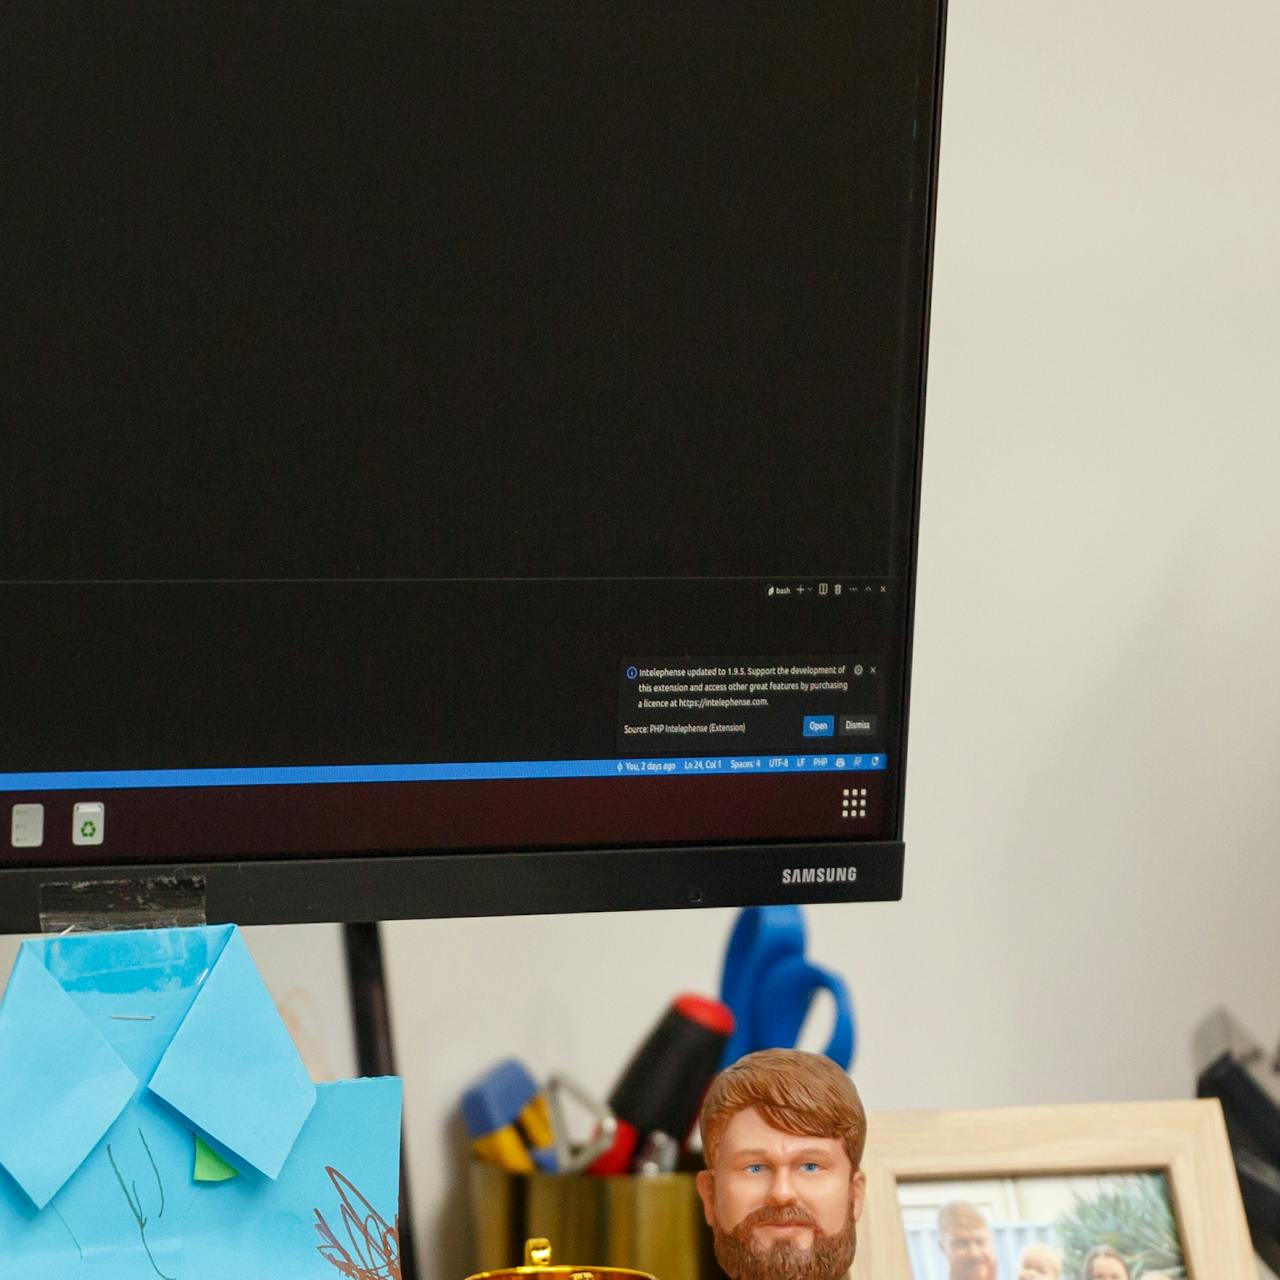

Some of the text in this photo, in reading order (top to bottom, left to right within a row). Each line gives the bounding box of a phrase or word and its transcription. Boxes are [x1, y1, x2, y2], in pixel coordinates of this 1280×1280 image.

[776, 586, 791, 595] bash
[639, 666, 686, 678] Intelephense
[687, 665, 716, 678] updated
[718, 665, 727, 676] to
[747, 665, 776, 677] Support
[777, 664, 790, 675] the
[790, 664, 837, 676] development
[838, 664, 846, 674] of
[638, 681, 848, 693] this extension and access other great features by purchasing
[643, 699, 669, 708] licence
[669, 699, 678, 708] at
[624, 722, 746, 735] Source: PHP Intelephense (Extension)
[809, 721, 828, 731] Open
[845, 720, 870, 730] Dismiss
[625, 761, 640, 772] You,
[647, 761, 662, 772] days
[663, 762, 676, 772] ago
[684, 760, 693, 770] Ln
[705, 759, 717, 770] Col
[730, 759, 754, 771] Spaces:
[768, 758, 789, 768] UTF-8
[797, 758, 806, 768] LF
[813, 757, 828, 767] PHP
[782, 866, 857, 884] SAMSUNG
